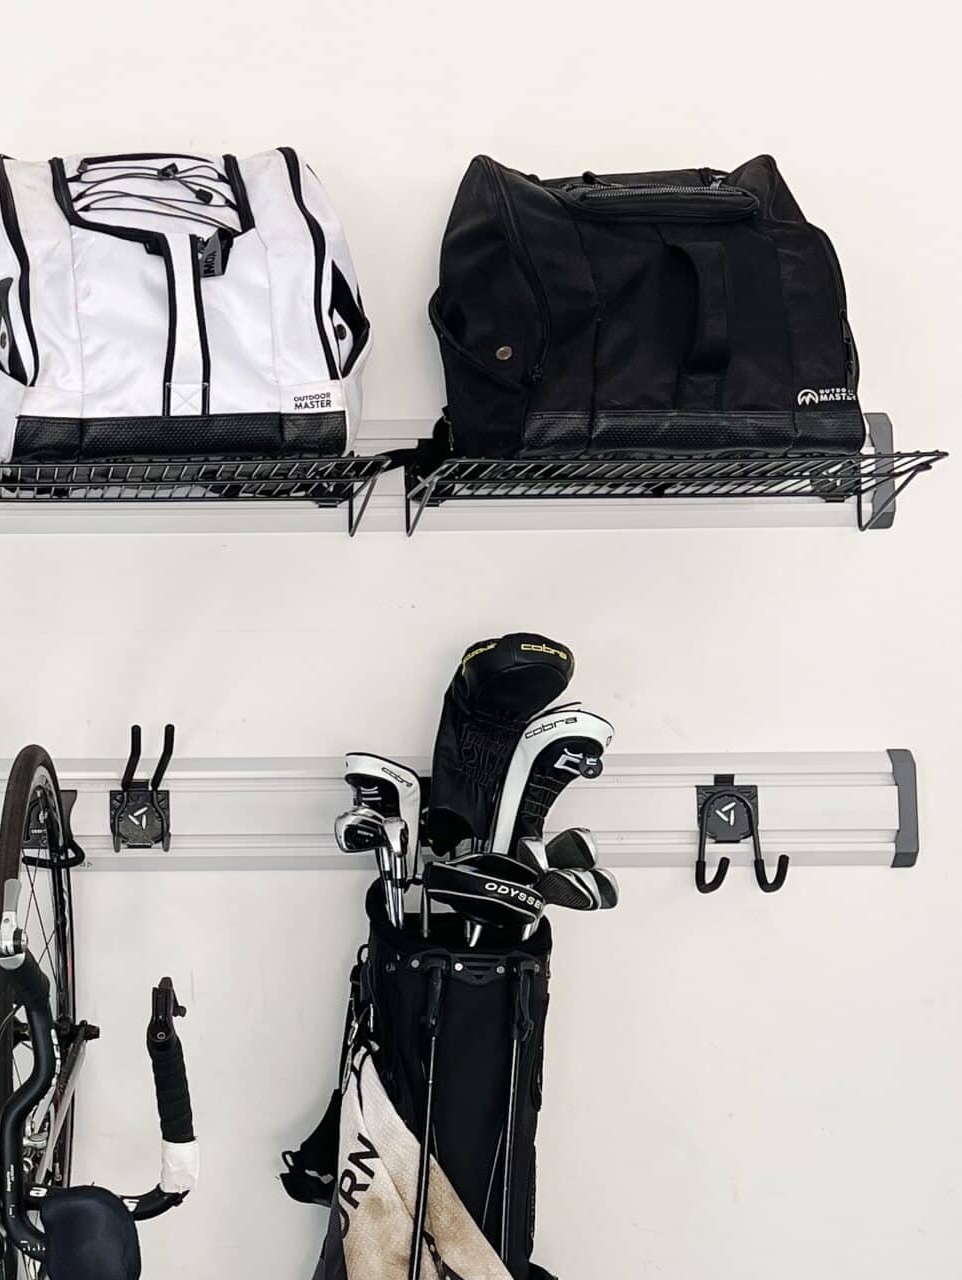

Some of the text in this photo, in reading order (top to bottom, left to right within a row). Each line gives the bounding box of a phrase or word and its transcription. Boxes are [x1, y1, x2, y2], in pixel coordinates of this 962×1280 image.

[294, 392, 331, 401] OUTDOOR
[294, 400, 332, 409] MASTER
[521, 643, 568, 660] cobra
[525, 717, 577, 739] cobra
[485, 882, 545, 909] ODYSSE
